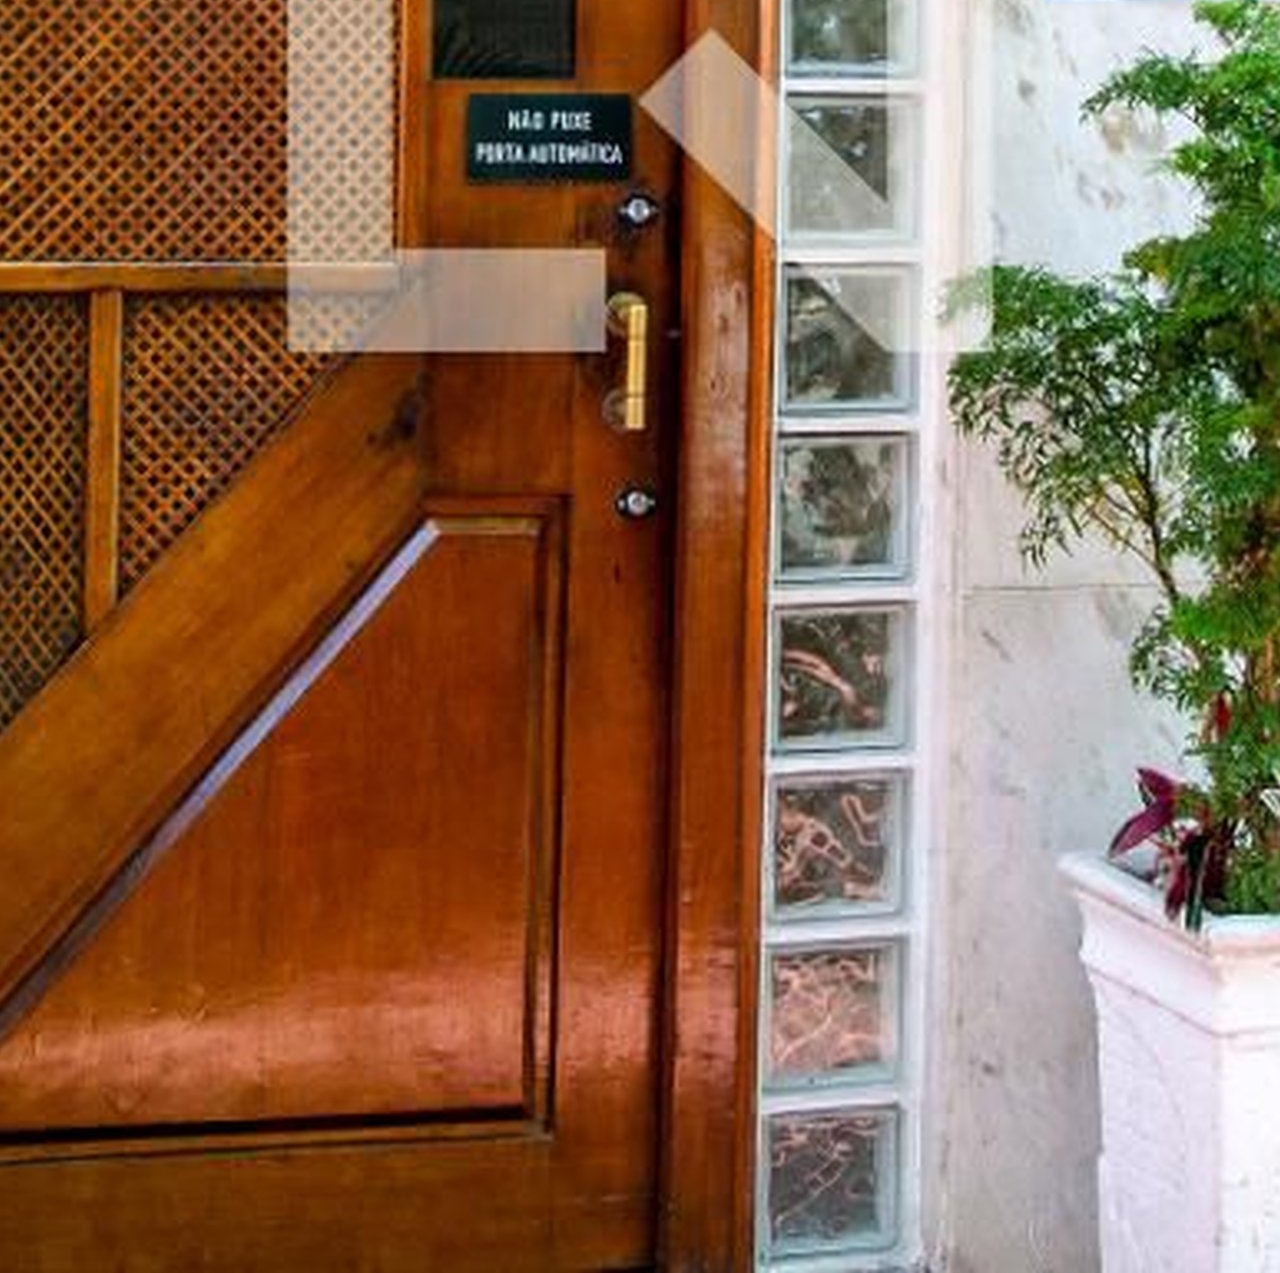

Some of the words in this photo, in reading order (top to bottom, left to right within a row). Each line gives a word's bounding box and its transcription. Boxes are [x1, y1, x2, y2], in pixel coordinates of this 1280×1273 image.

[507, 108, 546, 130] NÃO
[550, 110, 593, 131] PUXE
[475, 142, 524, 164] PORTA
[528, 138, 624, 165] AUTOMÁTICA
